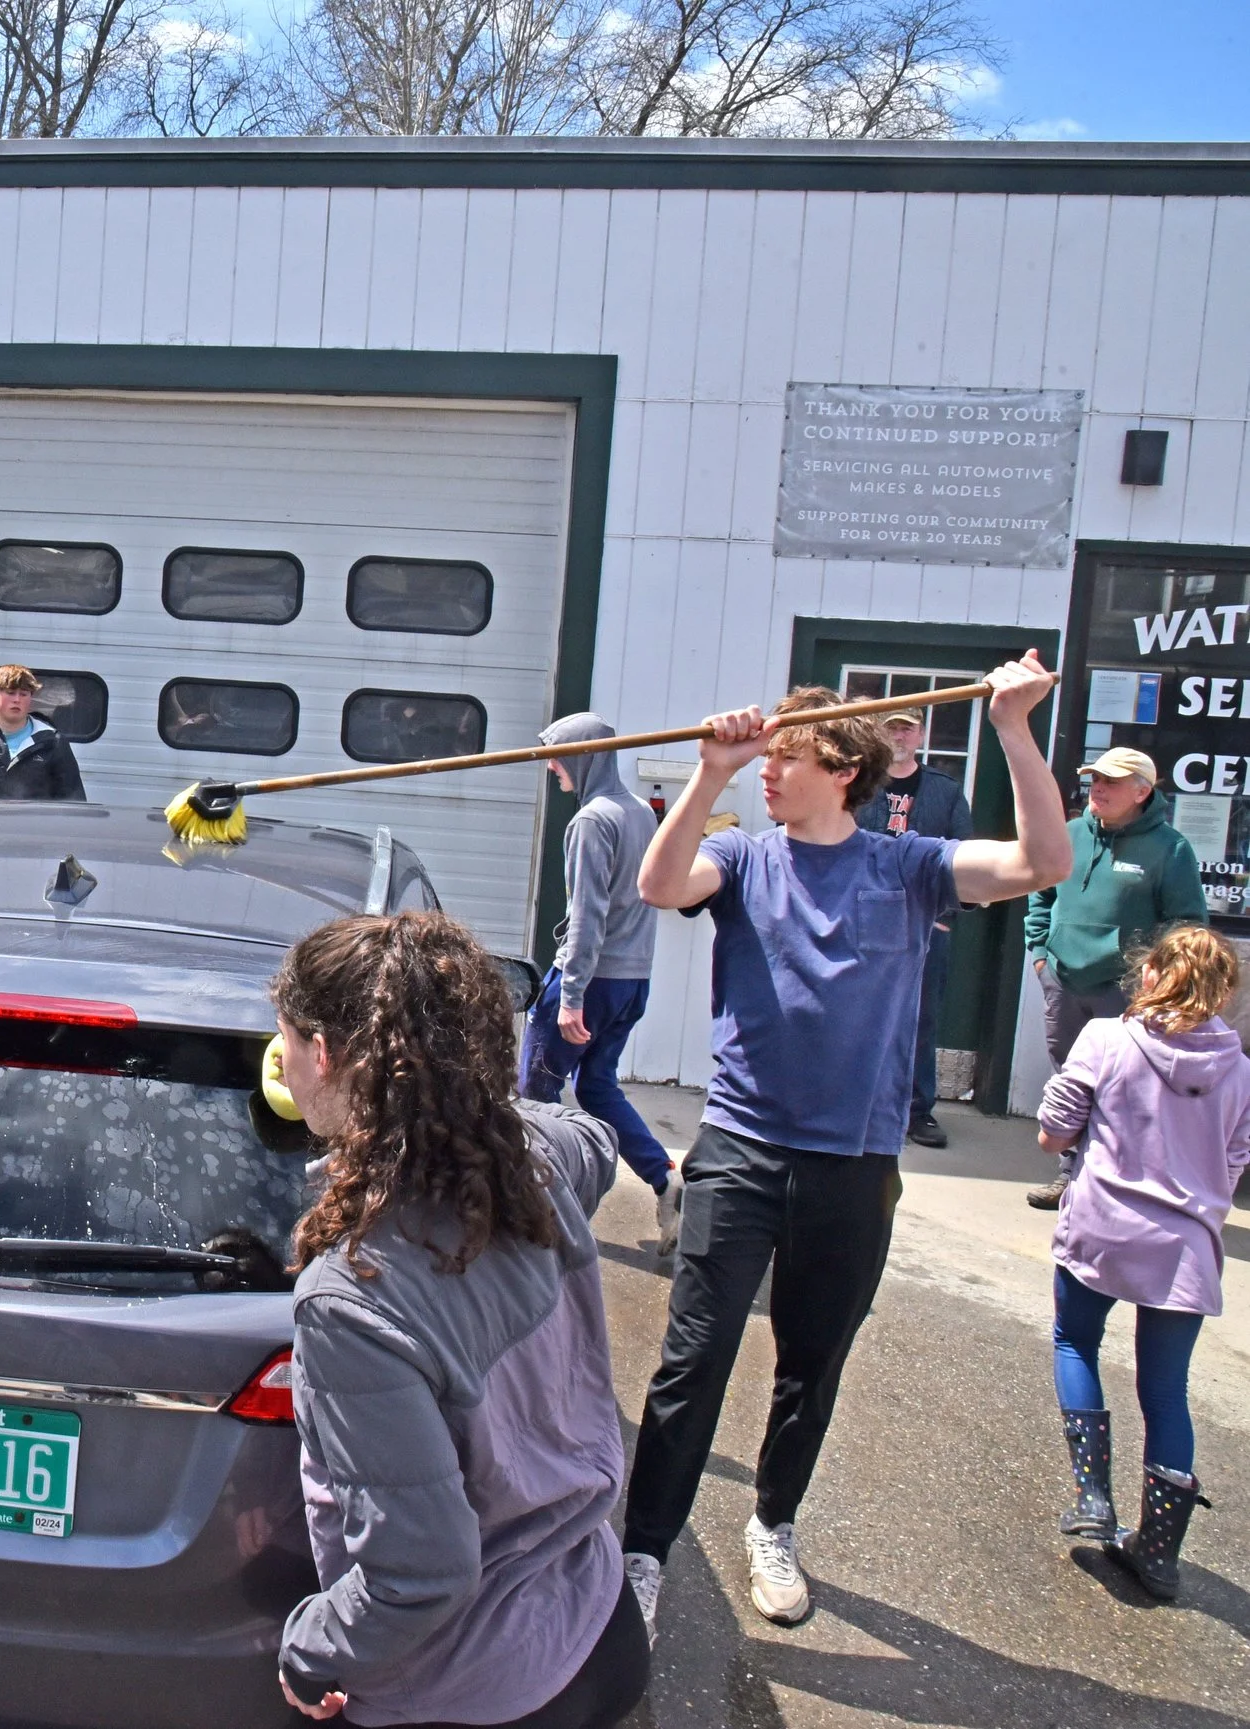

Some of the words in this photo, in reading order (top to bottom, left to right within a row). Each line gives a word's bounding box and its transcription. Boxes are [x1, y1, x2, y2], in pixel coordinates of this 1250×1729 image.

[804, 401, 881, 417] THANK
[890, 404, 937, 419] YOU
[946, 405, 990, 420] FOR
[999, 407, 1062, 423] YOUR
[803, 425, 939, 443] CONTINUED
[948, 430, 1059, 447] SUPPORT!
[803, 460, 893, 475] SERVICING
[901, 463, 931, 476] ALL
[938, 465, 1053, 480] AUTOMOTIVE
[850, 481, 906, 494] MAKES
[913, 483, 925, 495] &
[932, 484, 1002, 498] MODELS
[797, 510, 900, 524] SUPPORTING
[906, 514, 939, 526] OUR
[946, 516, 1050, 530] COMMUNITY
[839, 529, 871, 540] FOR
[877, 530, 920, 543] OVER
[926, 532, 946, 543] 20
[952, 533, 1003, 546] YEARS
[1133, 604, 1250, 655] WAT
[35, 1517, 60, 1529] 02/24
